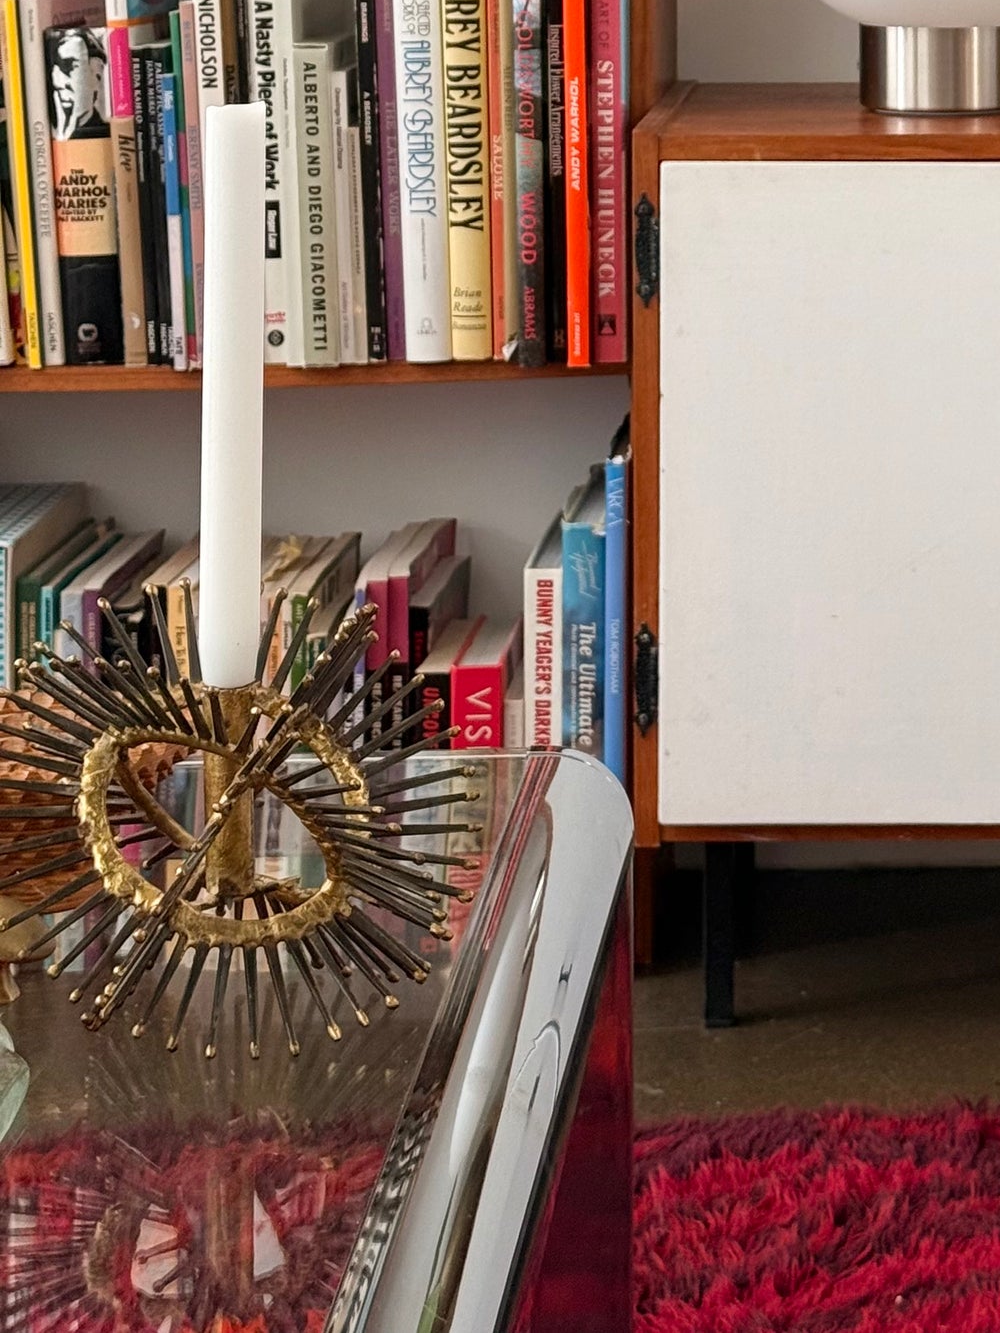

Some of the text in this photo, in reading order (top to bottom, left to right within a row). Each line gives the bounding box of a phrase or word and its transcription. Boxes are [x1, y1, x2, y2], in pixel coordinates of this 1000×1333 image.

[402, 23, 416, 36] OF
[415, 0, 432, 37] SELECTED
[598, 0, 610, 24] ART
[599, 33, 610, 49] OF
[155, 62, 165, 136] PABLO PICASSO
[254, 0, 280, 191] A Nasty Piece of Work
[385, 101, 396, 130] THE
[515, 10, 536, 169] GOLDSWORTHY
[547, 24, 565, 176] Inspired Flower Arrangements
[33, 121, 47, 176] GEORGIA
[118, 133, 136, 173] klee
[188, 124, 200, 176] JEREMY
[401, 40, 437, 218] AUBREY BEARDSLEY
[446, 63, 484, 233] BEARDSLEY
[569, 77, 581, 191] ANDY WARHOL
[59, 174, 98, 186] ANDY
[387, 135, 400, 186] LATER
[493, 133, 504, 202] SALOME
[596, 58, 616, 298] STEPHEN HUNECK
[54, 197, 107, 209] DIARIES
[191, 178, 202, 211] SMITH
[303, 61, 328, 352] ALBERTO AND DIEGO GIACOMETTI
[388, 190, 401, 236] WORK
[520, 192, 537, 265] WOOD
[453, 287, 482, 297] Brian
[523, 285, 537, 340] ABRAMS
[47, 312, 56, 352] TASCHEN
[147, 320, 156, 353] TASCHEN
[160, 322, 168, 356] TASCHEN
[536, 579, 553, 626] BUNNY
[535, 630, 554, 696] YEAGER'S
[609, 618, 620, 694] TOM ROBOTHAM
[578, 622, 597, 745] The Ultimate
